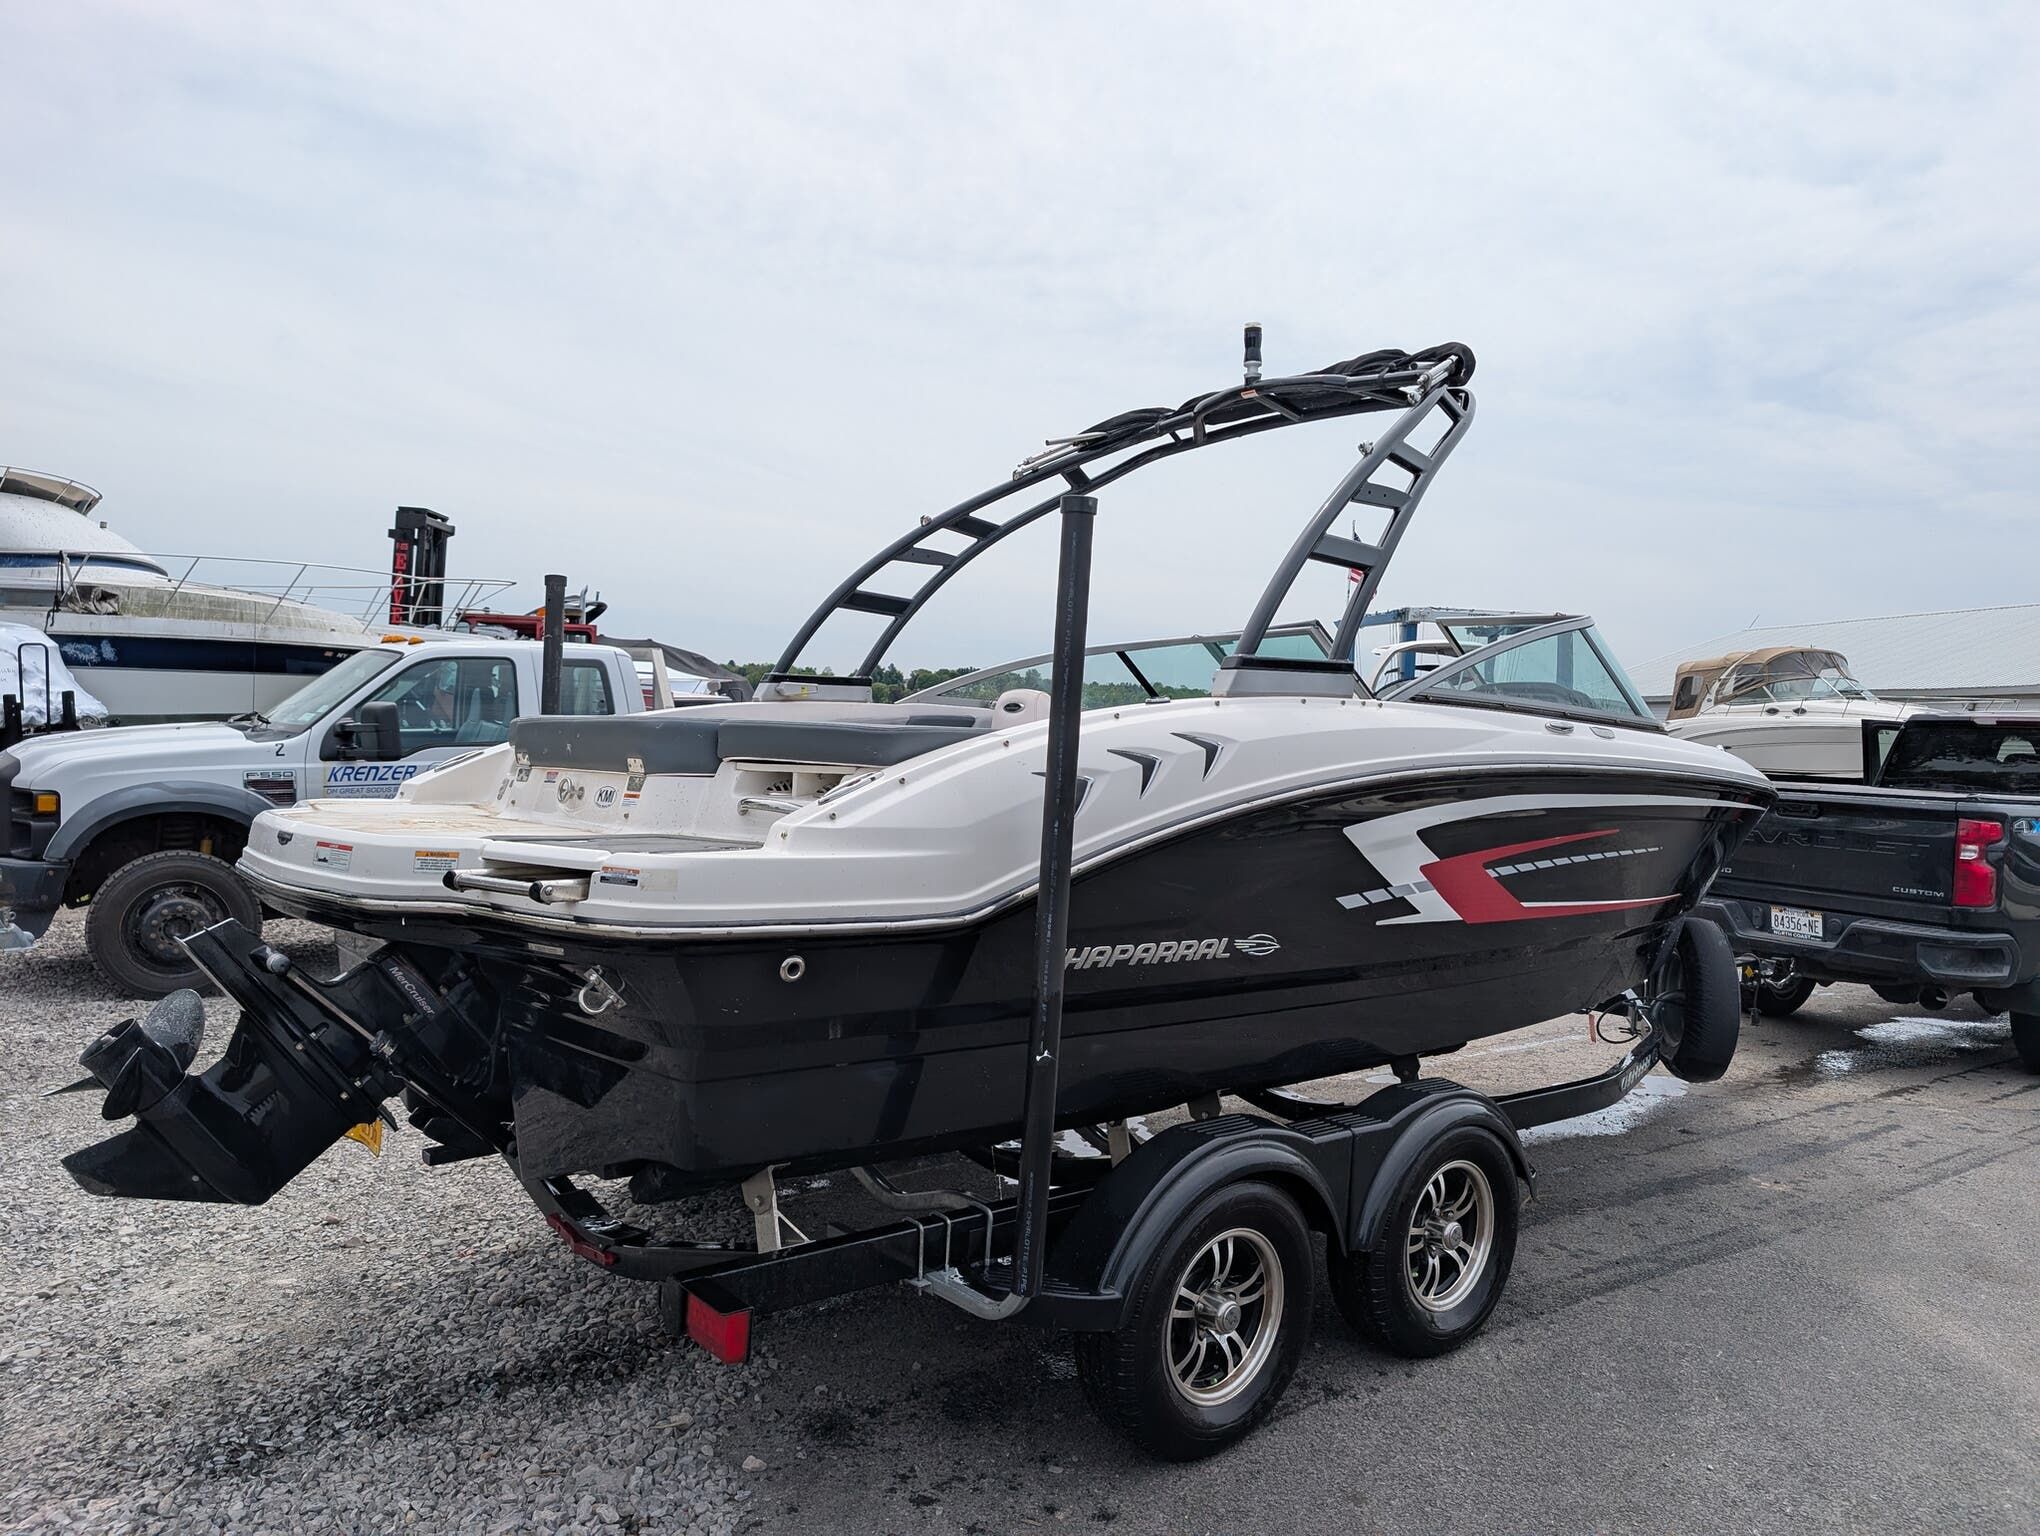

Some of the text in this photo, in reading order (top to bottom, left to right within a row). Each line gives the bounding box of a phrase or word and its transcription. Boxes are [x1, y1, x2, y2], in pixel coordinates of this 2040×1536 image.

[275, 743, 285, 757] 2
[328, 765, 417, 782] KRENZER
[597, 789, 616, 803] KMI
[1892, 886, 1945, 898] CUSTOM
[1774, 914, 1801, 931] 84356
[1065, 938, 1230, 970] HAPARRAL
[389, 966, 435, 1015] MerCruiser
